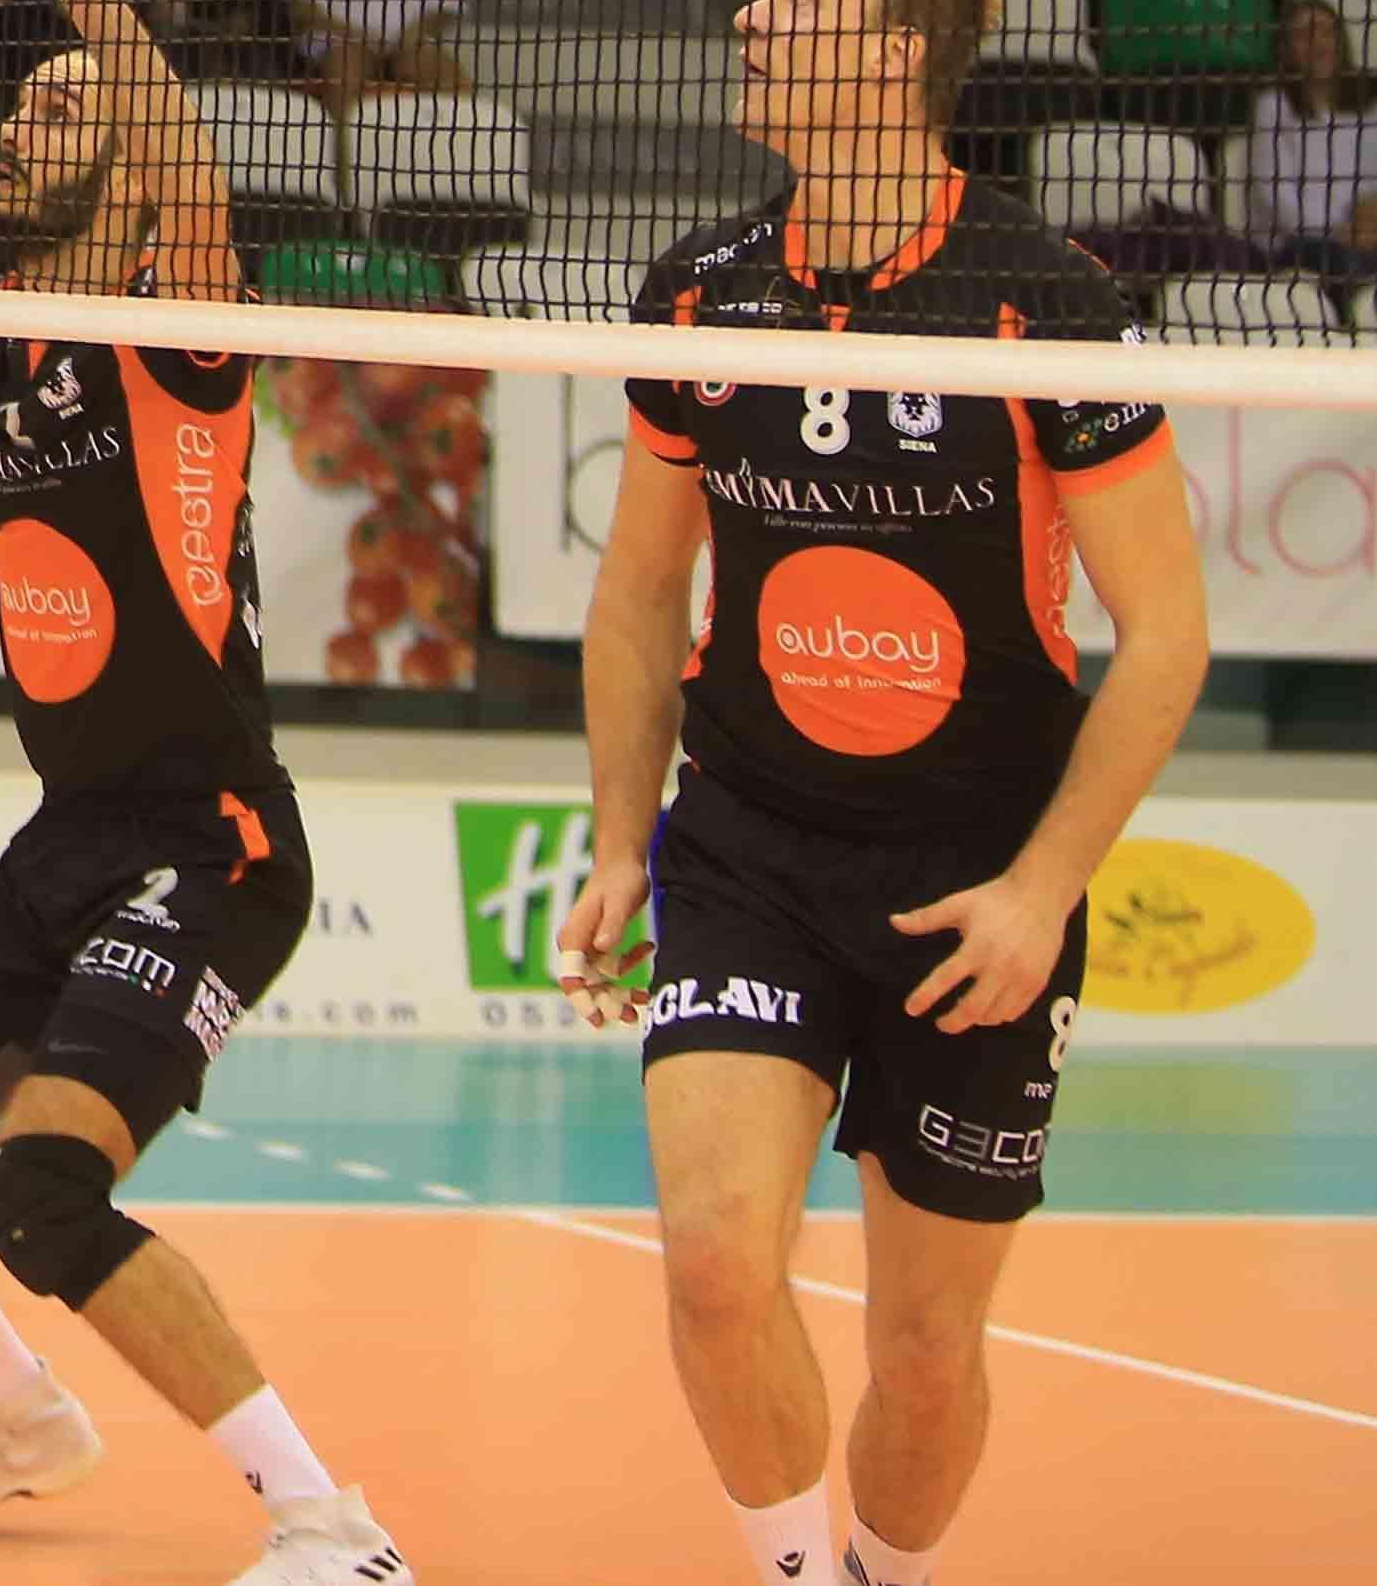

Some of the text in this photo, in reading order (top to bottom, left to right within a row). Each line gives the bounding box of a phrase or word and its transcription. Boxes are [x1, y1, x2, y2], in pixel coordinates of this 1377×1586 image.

[799, 386, 851, 456] 8
[776, 613, 941, 673] aubay
[126, 865, 179, 920] 2
[1049, 995, 1077, 1072] 8
